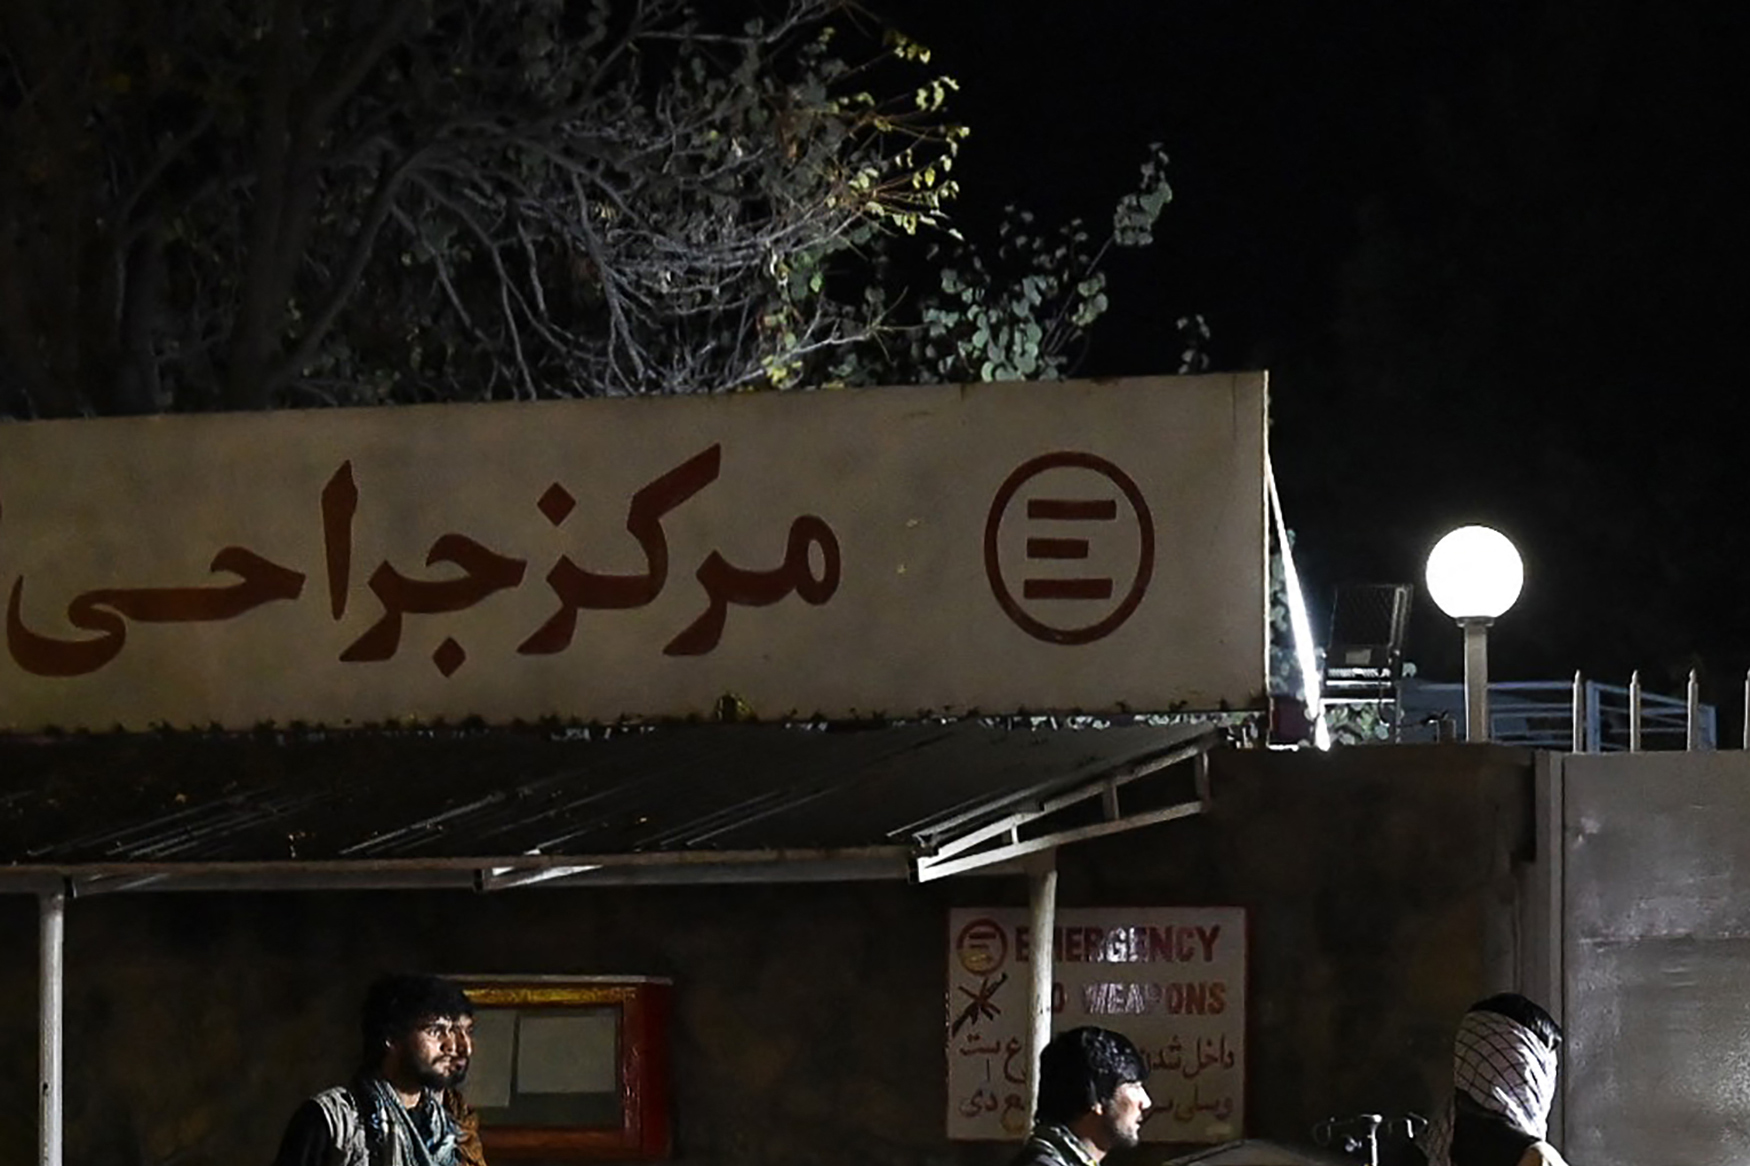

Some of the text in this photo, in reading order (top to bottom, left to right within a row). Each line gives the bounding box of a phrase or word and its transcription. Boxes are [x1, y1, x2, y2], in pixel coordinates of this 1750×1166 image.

[6, 442, 842, 677] مرکز جراحی
[1082, 982, 1226, 1014] WEAPONS
